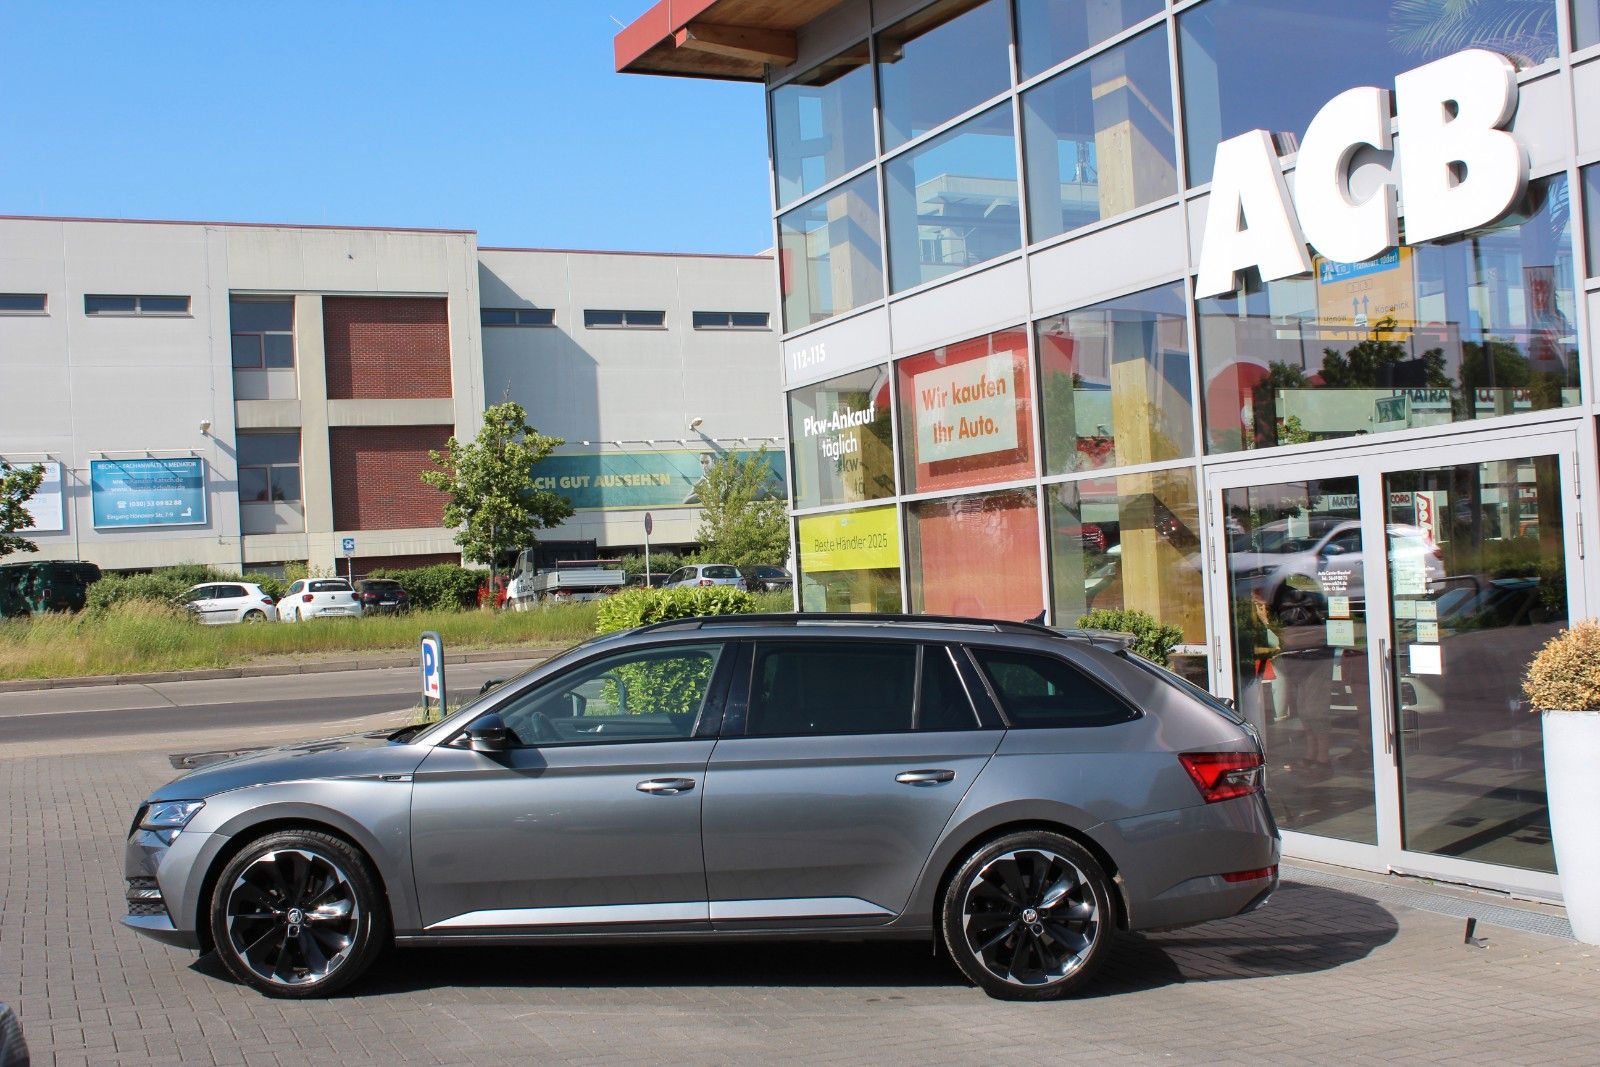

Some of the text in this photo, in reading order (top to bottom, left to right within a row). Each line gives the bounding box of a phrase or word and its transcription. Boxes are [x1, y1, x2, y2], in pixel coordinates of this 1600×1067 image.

[1195, 49, 1526, 300] ACB
[793, 342, 826, 371] 112-115
[922, 375, 1006, 412] Wir kaufen
[804, 401, 875, 437] Pkw-Ankauf
[933, 416, 999, 444] Ihr Auto.
[822, 431, 858, 461] täglich
[559, 476, 590, 489] GUT
[594, 473, 672, 488] AUSSEHEN
[814, 533, 888, 553] Beste Händler 2025
[423, 643, 436, 692] P
